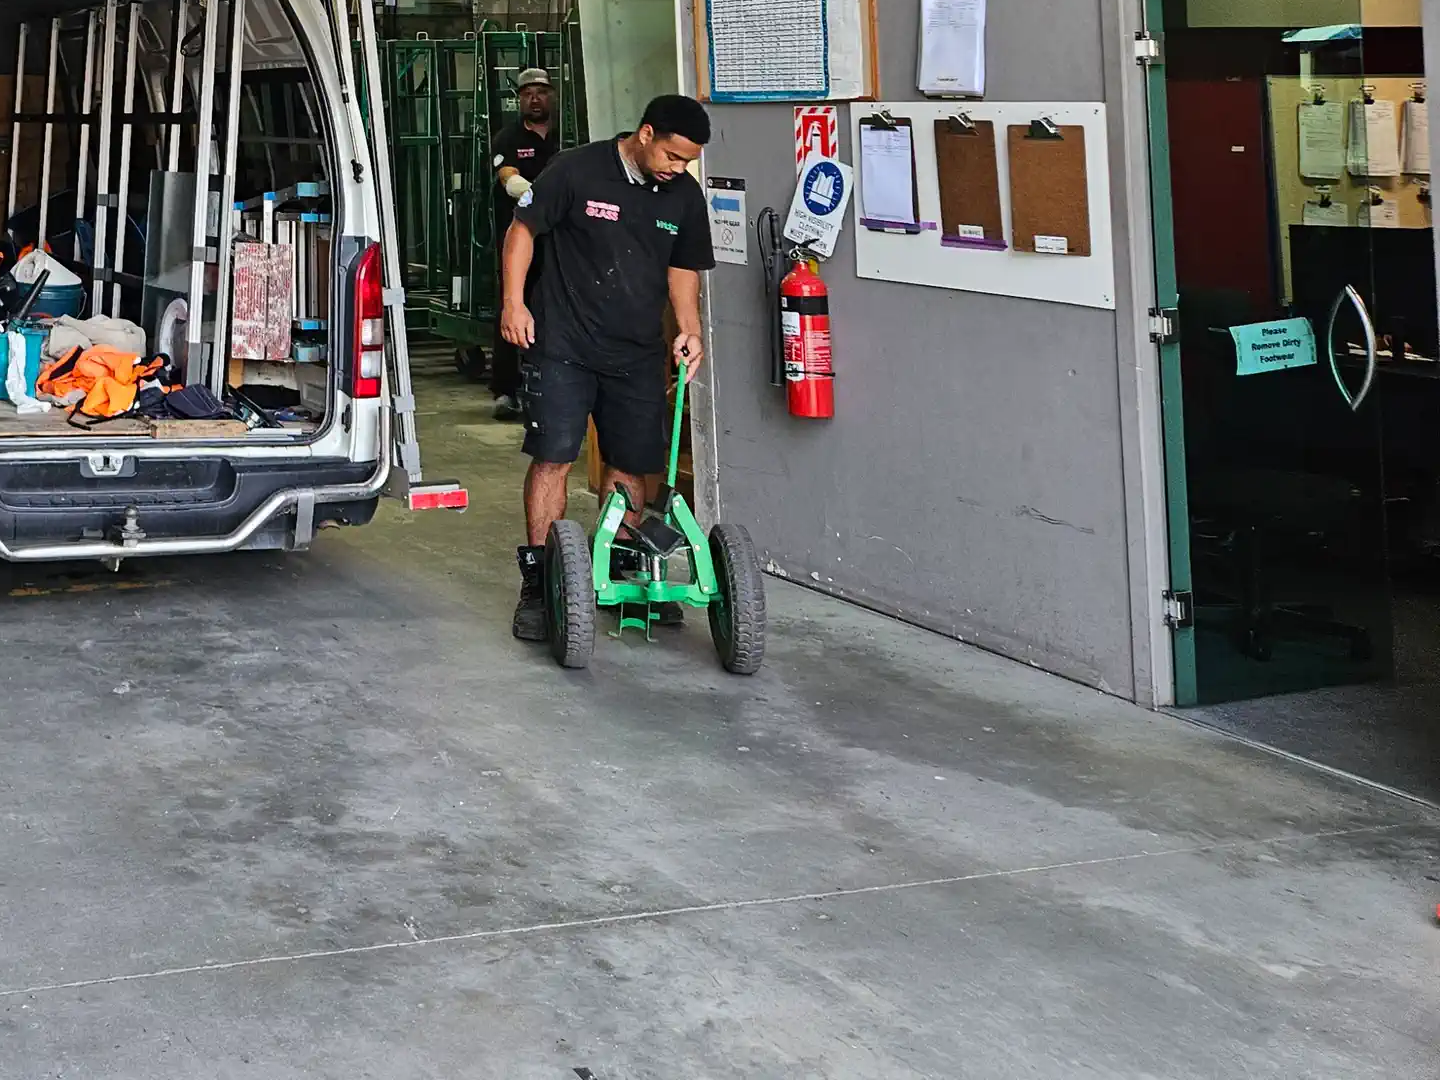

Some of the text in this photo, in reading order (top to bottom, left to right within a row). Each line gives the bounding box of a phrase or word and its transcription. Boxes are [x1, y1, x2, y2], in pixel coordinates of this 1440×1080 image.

[585, 206, 619, 222] GLASS
[1262, 328, 1287, 336] Please
[1252, 339, 1300, 351] Remove Dirty
[1260, 353, 1295, 363] Footwear
